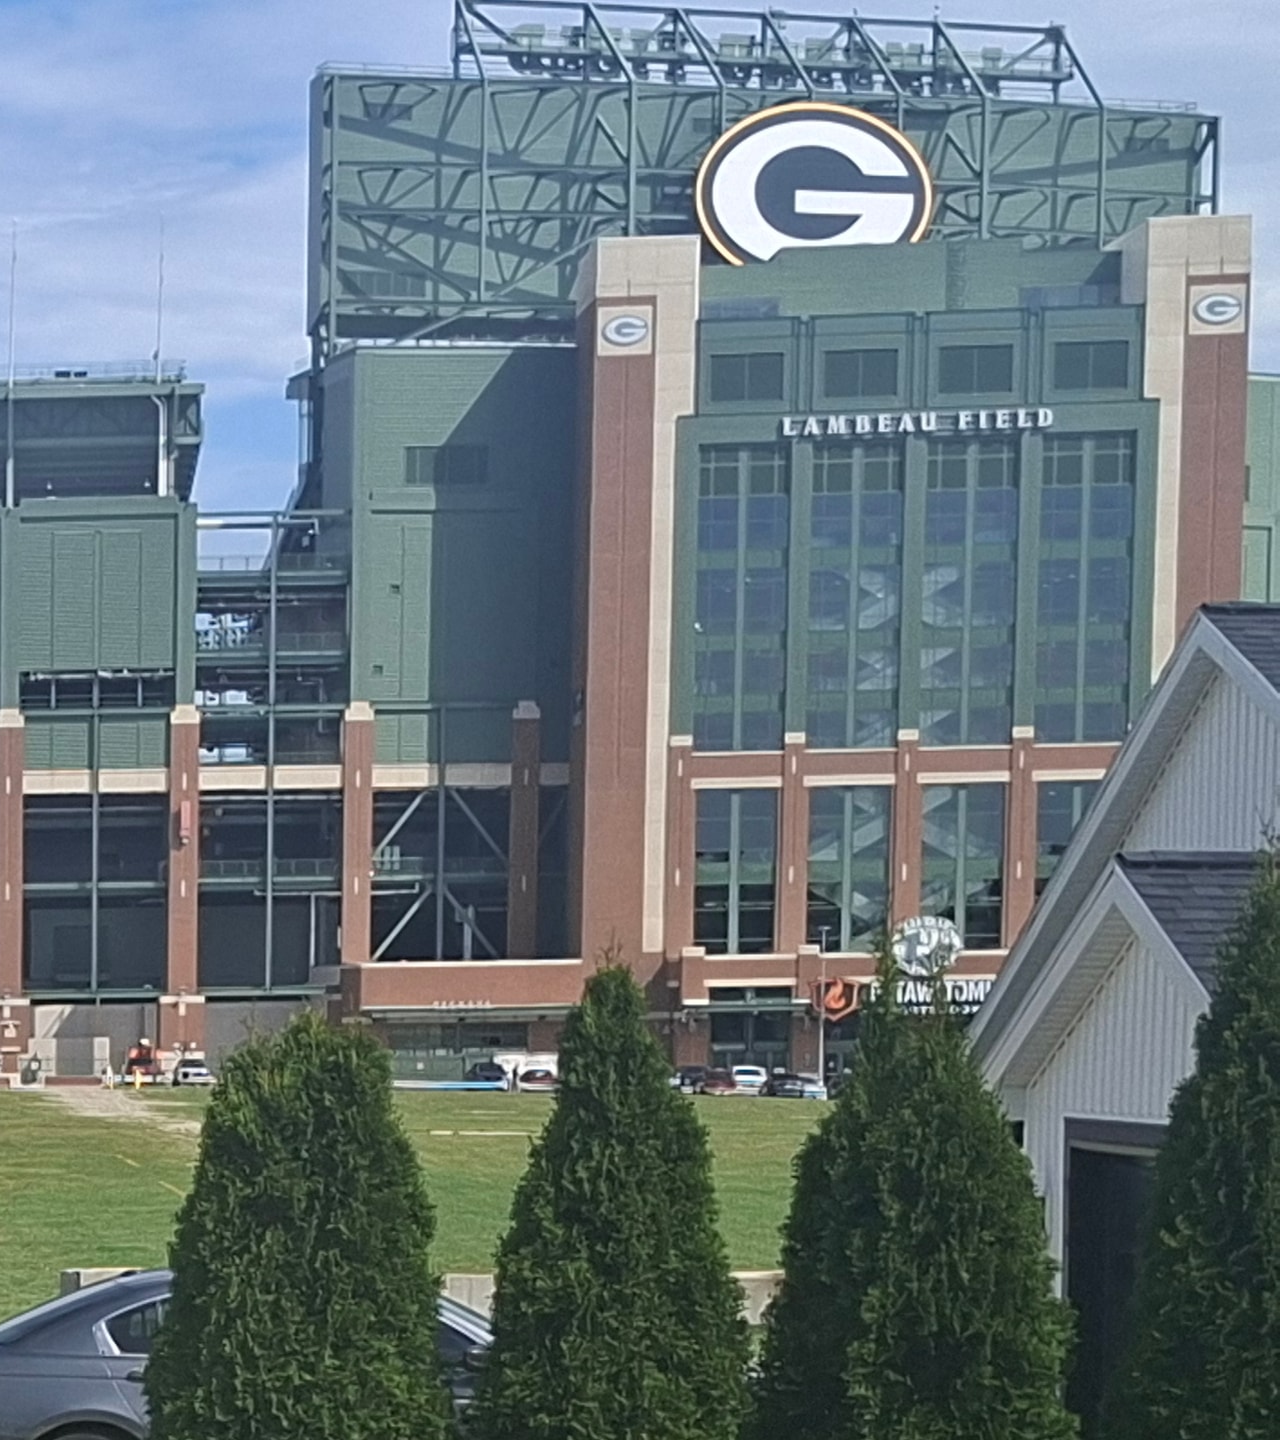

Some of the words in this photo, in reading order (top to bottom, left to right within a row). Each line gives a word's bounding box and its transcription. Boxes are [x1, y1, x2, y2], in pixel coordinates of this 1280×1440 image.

[712, 119, 915, 262] G
[1195, 294, 1240, 323] G
[603, 315, 647, 345] G
[781, 411, 938, 436] LAMBEAU
[957, 408, 1054, 430] FIELD
